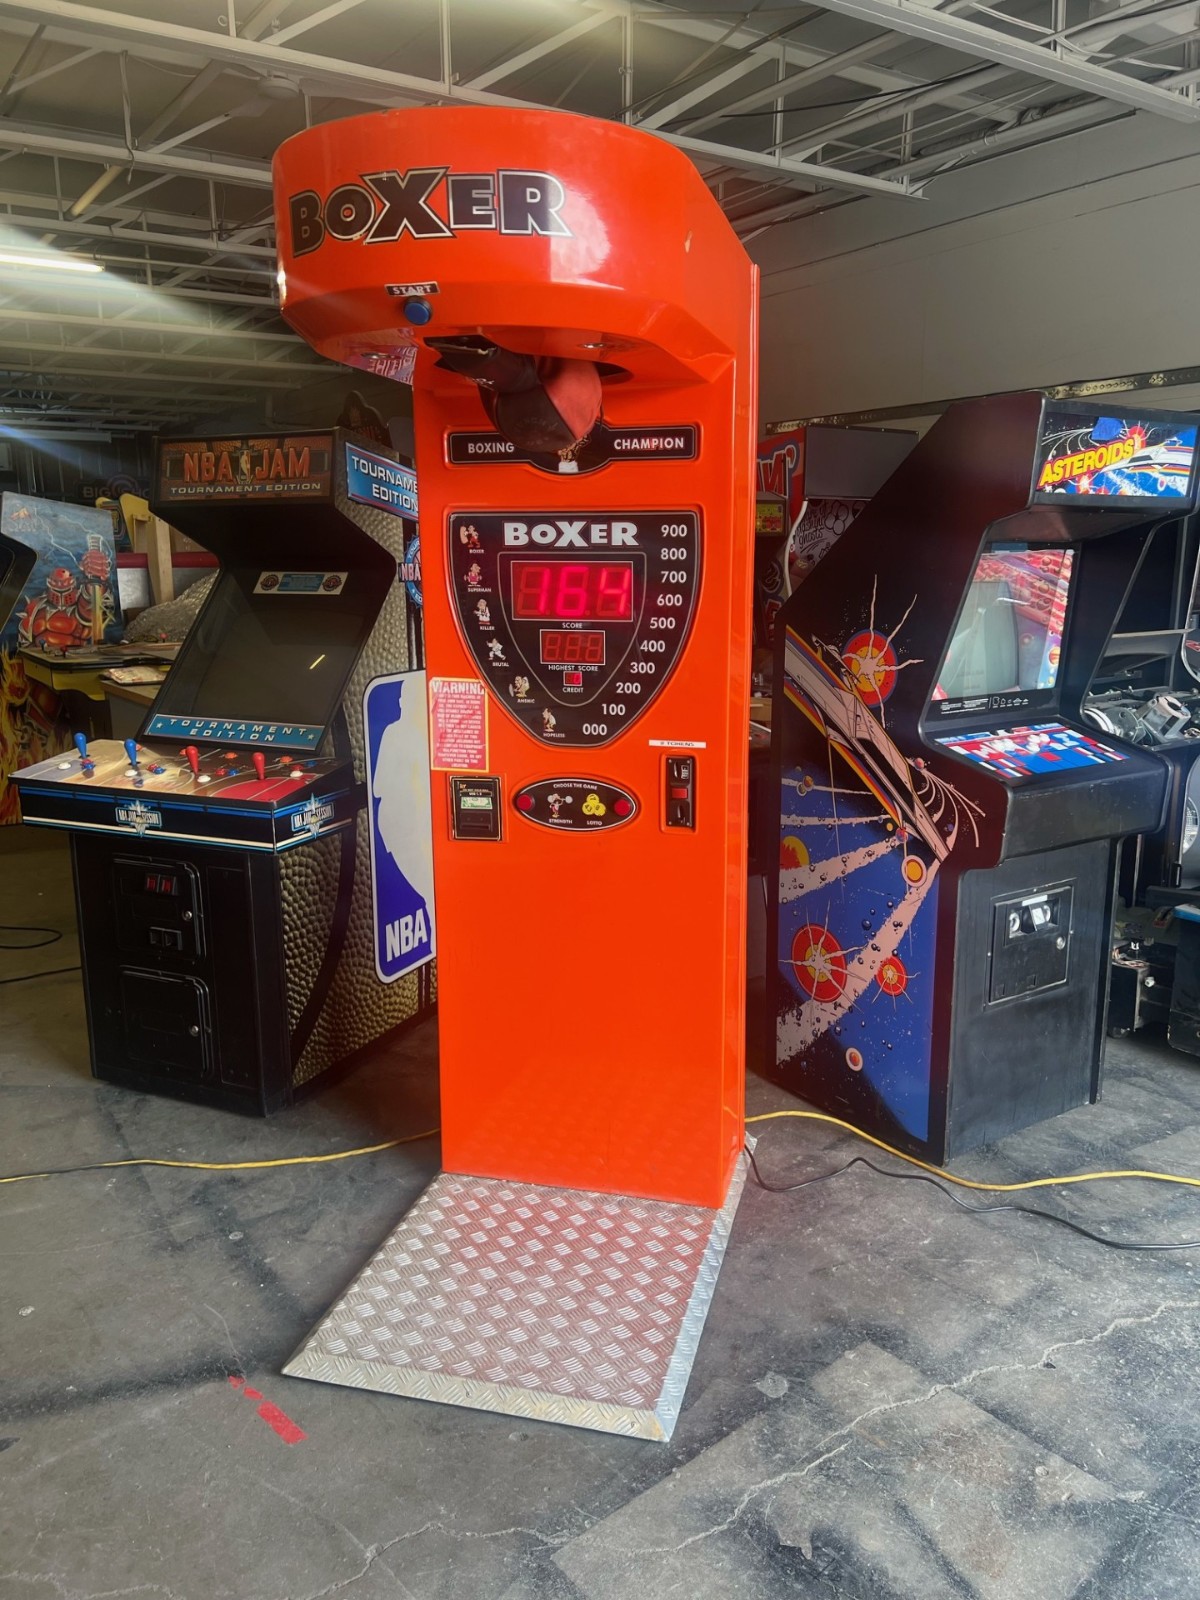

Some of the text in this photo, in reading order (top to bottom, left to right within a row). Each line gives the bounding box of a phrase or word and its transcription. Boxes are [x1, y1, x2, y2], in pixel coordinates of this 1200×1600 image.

[289, 166, 574, 258] BOXER
[392, 285, 432, 295] START
[467, 437, 684, 454] BOXING CHAMPION
[183, 447, 311, 483] NBA JAM
[1037, 438, 1135, 489] ASTEROIDS
[170, 483, 321, 494] TOURNAMENT EDITION
[503, 521, 639, 547] BOXER
[661, 524, 688, 538] 900
[661, 547, 688, 561] 800
[401, 563, 421, 581] NBA
[661, 571, 687, 584] 700
[656, 594, 683, 607] 600
[650, 617, 676, 630] 500
[640, 640, 666, 653] 400
[629, 661, 656, 674] 300
[615, 681, 641, 694] 200
[601, 703, 626, 716] 100
[170, 718, 307, 735] TOURNAMENT
[582, 724, 607, 737] 000
[189, 728, 276, 742] EDITION
[385, 908, 428, 963] NBA
